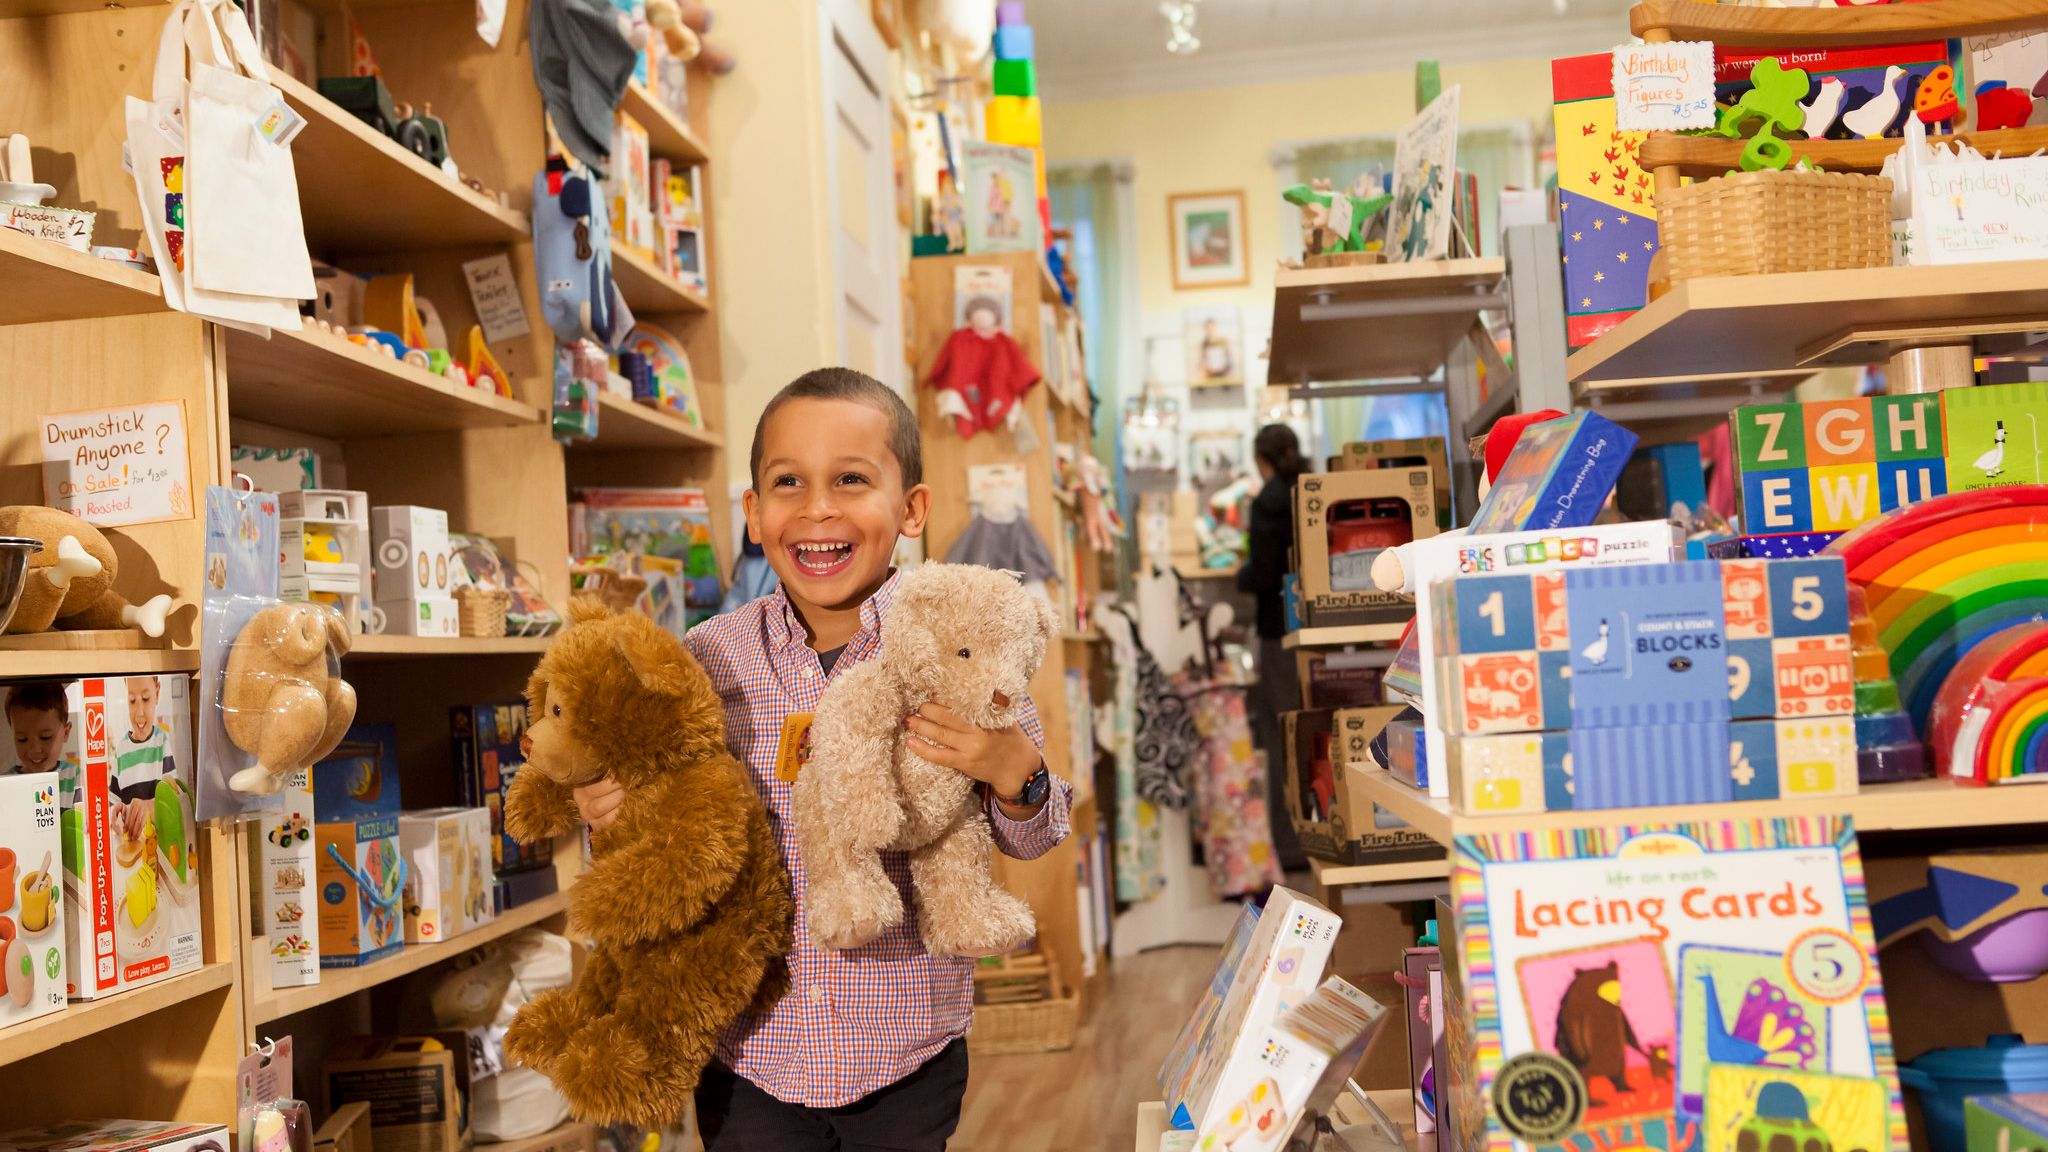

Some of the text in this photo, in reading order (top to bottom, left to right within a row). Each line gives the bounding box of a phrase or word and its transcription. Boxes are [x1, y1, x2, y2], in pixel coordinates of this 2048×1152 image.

[1792, 49, 1827, 63] born?
[1621, 52, 1689, 84] Birthday
[1627, 80, 1684, 112] Figures
[1928, 166, 2010, 197] Birthday
[12, 206, 60, 223] Wooden
[40, 223, 66, 239] Knife
[47, 411, 145, 444] Drumstick
[76, 439, 146, 471] Anyone
[58, 480, 81, 495] On
[85, 464, 129, 491] Sale!
[1549, 438, 1607, 530] tton Drawstring Bag
[87, 495, 131, 515] Roasted
[1507, 538, 1649, 564] BLOCK puzzle
[1314, 594, 1348, 608] Fire
[1636, 633, 1721, 654] BLOCKS
[87, 738, 105, 752] Hape
[35, 807, 54, 818] PLAN
[36, 817, 55, 828] TOYS
[1393, 831, 1433, 844] Truc
[1514, 881, 1823, 943] Lacing Cards
[1811, 942, 1843, 983] 5
